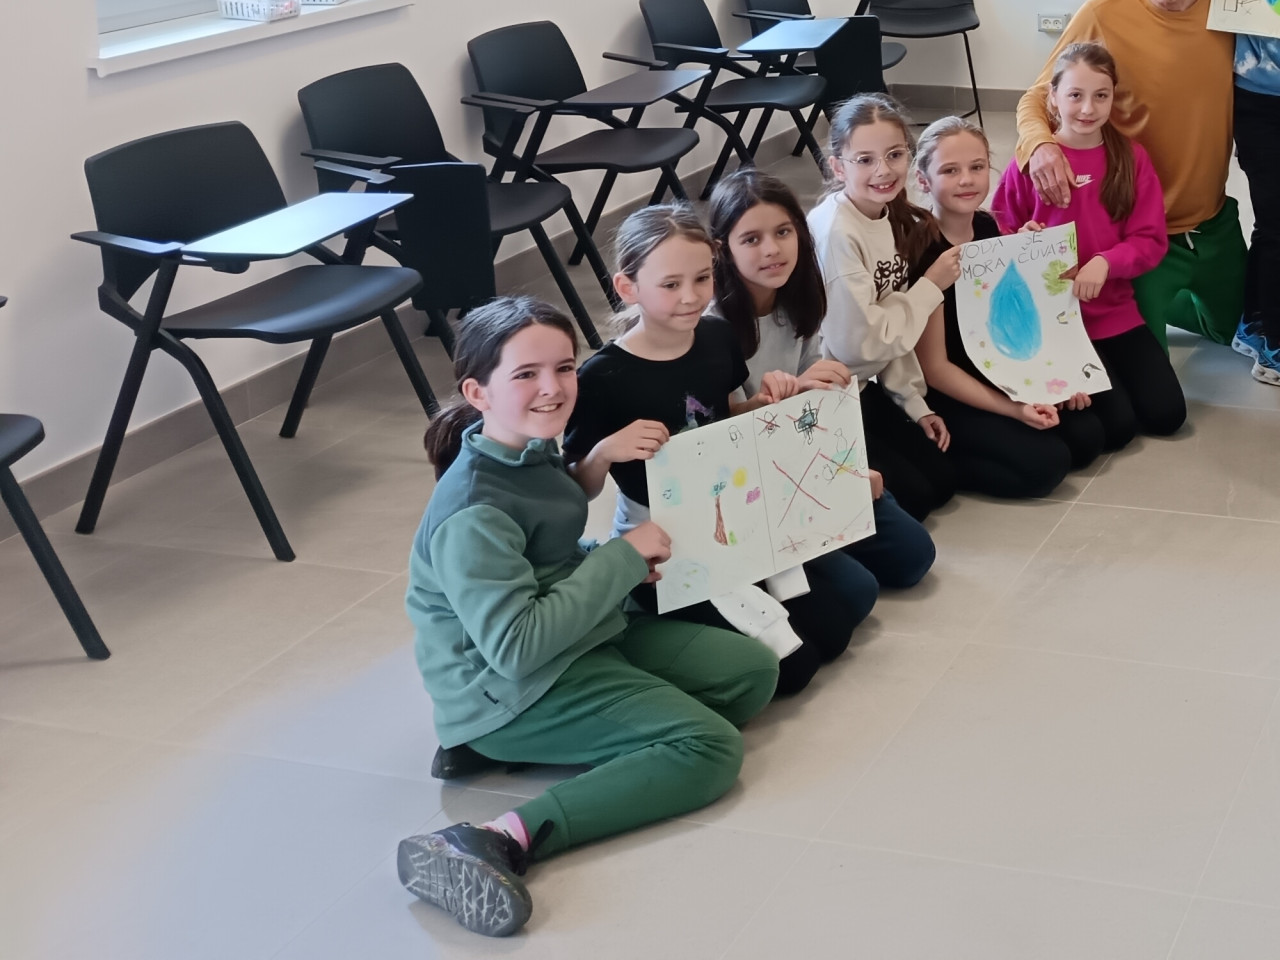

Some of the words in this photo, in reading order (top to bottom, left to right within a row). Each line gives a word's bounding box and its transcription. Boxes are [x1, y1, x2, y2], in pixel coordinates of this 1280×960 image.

[959, 239, 1004, 261] VODA
[1025, 231, 1043, 246] SE
[962, 257, 1006, 281] MORA
